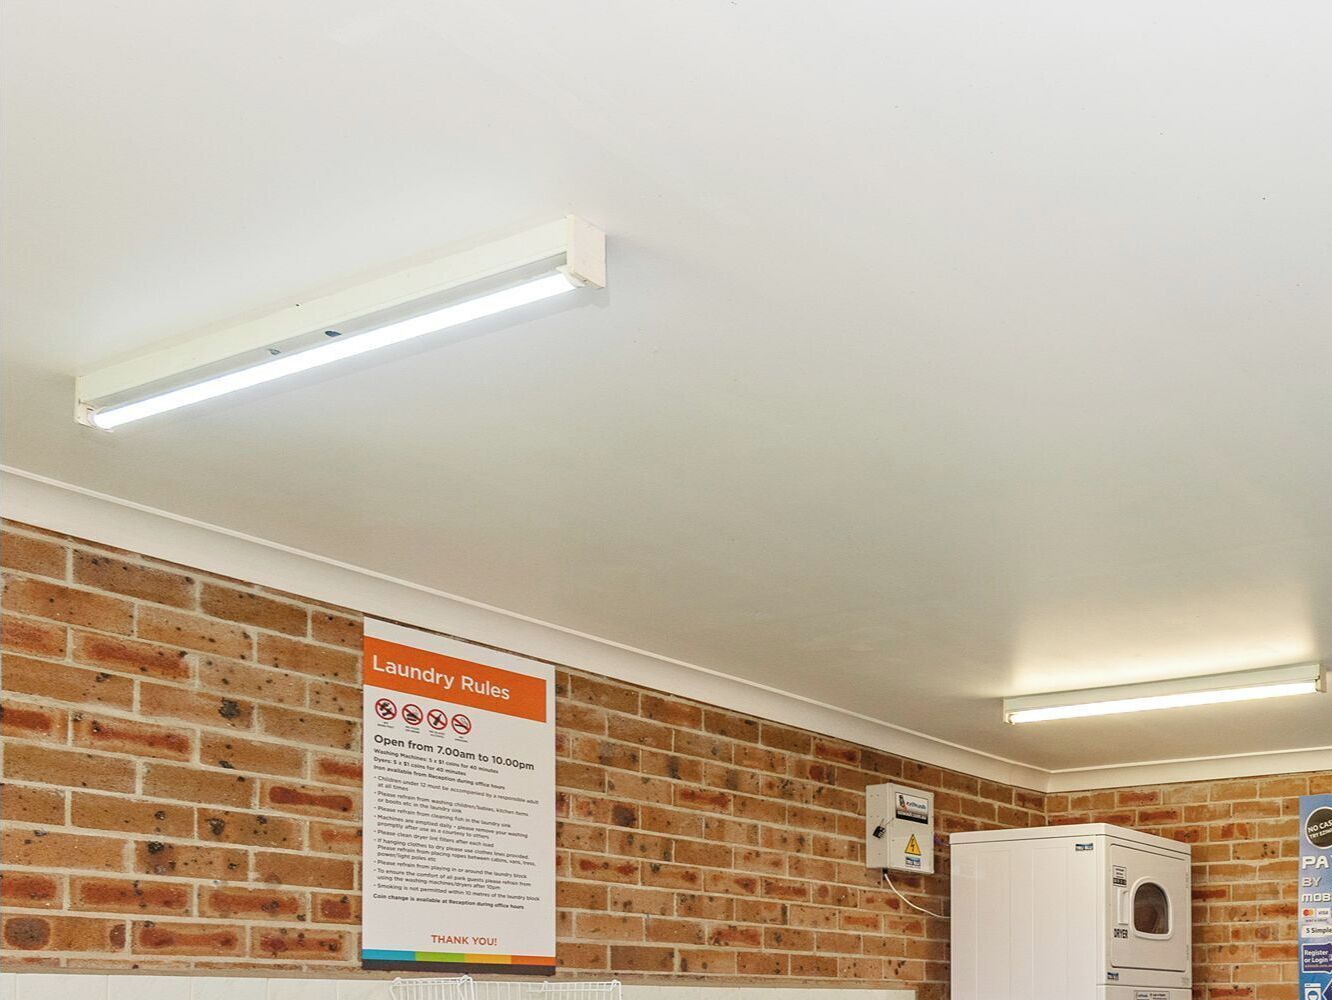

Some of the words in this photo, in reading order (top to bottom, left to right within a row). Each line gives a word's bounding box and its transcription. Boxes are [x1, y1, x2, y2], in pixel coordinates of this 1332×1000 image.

[372, 654, 455, 690] Laundry
[460, 675, 511, 700] Rules
[374, 734, 405, 747] Open
[408, 740, 434, 753] from
[437, 745, 475, 760] 7.00am
[478, 753, 489, 763] to
[491, 755, 535, 771] 10.00pm
[1307, 824, 1319, 833] NO
[1302, 876, 1322, 888] BY
[431, 934, 469, 945] THANK
[471, 936, 498, 946] YOU!
[1304, 949, 1329, 957] Register
